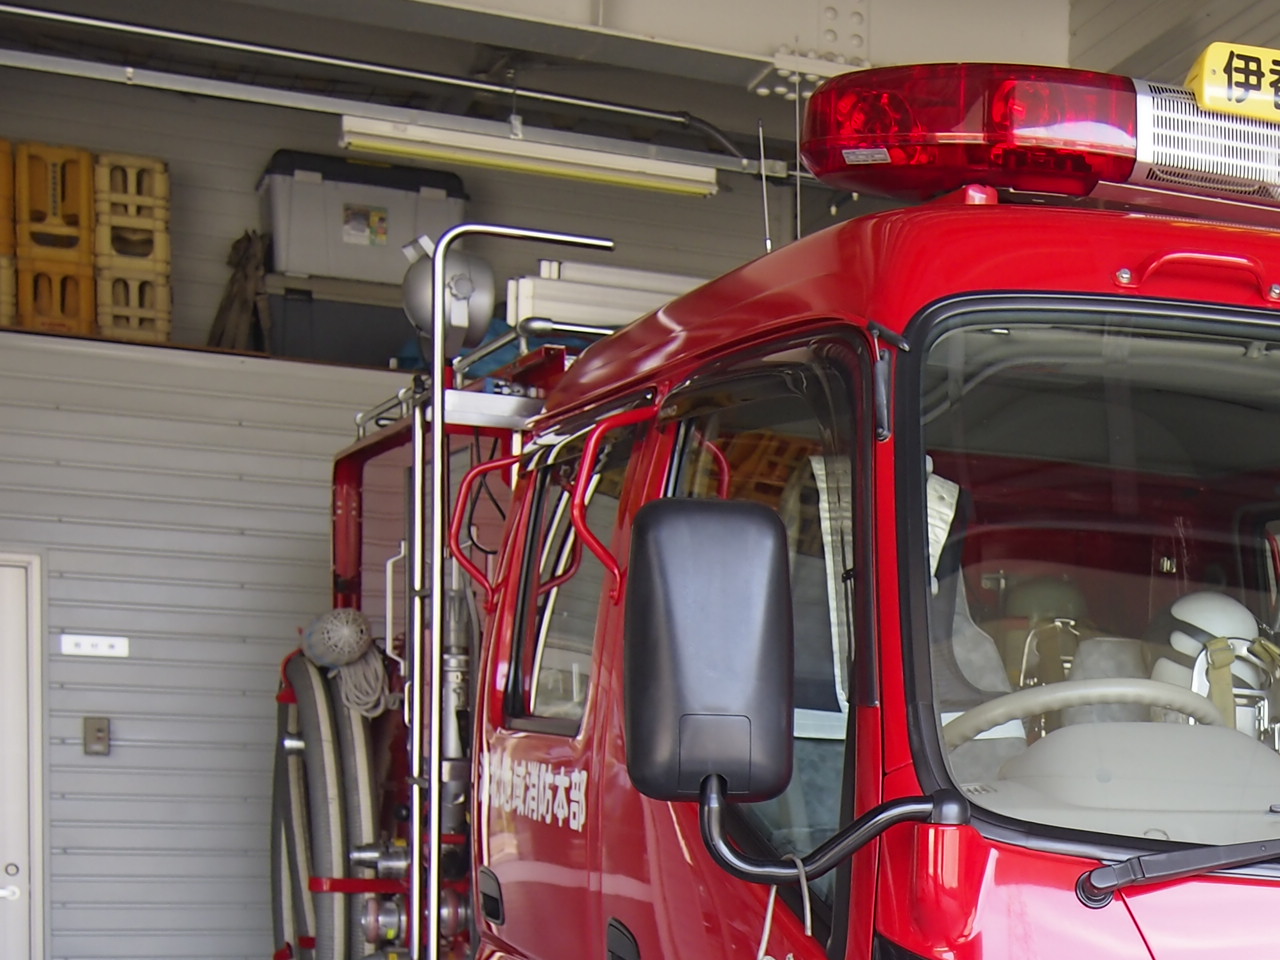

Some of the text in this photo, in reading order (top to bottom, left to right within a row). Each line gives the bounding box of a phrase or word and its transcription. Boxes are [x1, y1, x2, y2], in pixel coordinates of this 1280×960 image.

[479, 748, 588, 833] 北地域消防本部
